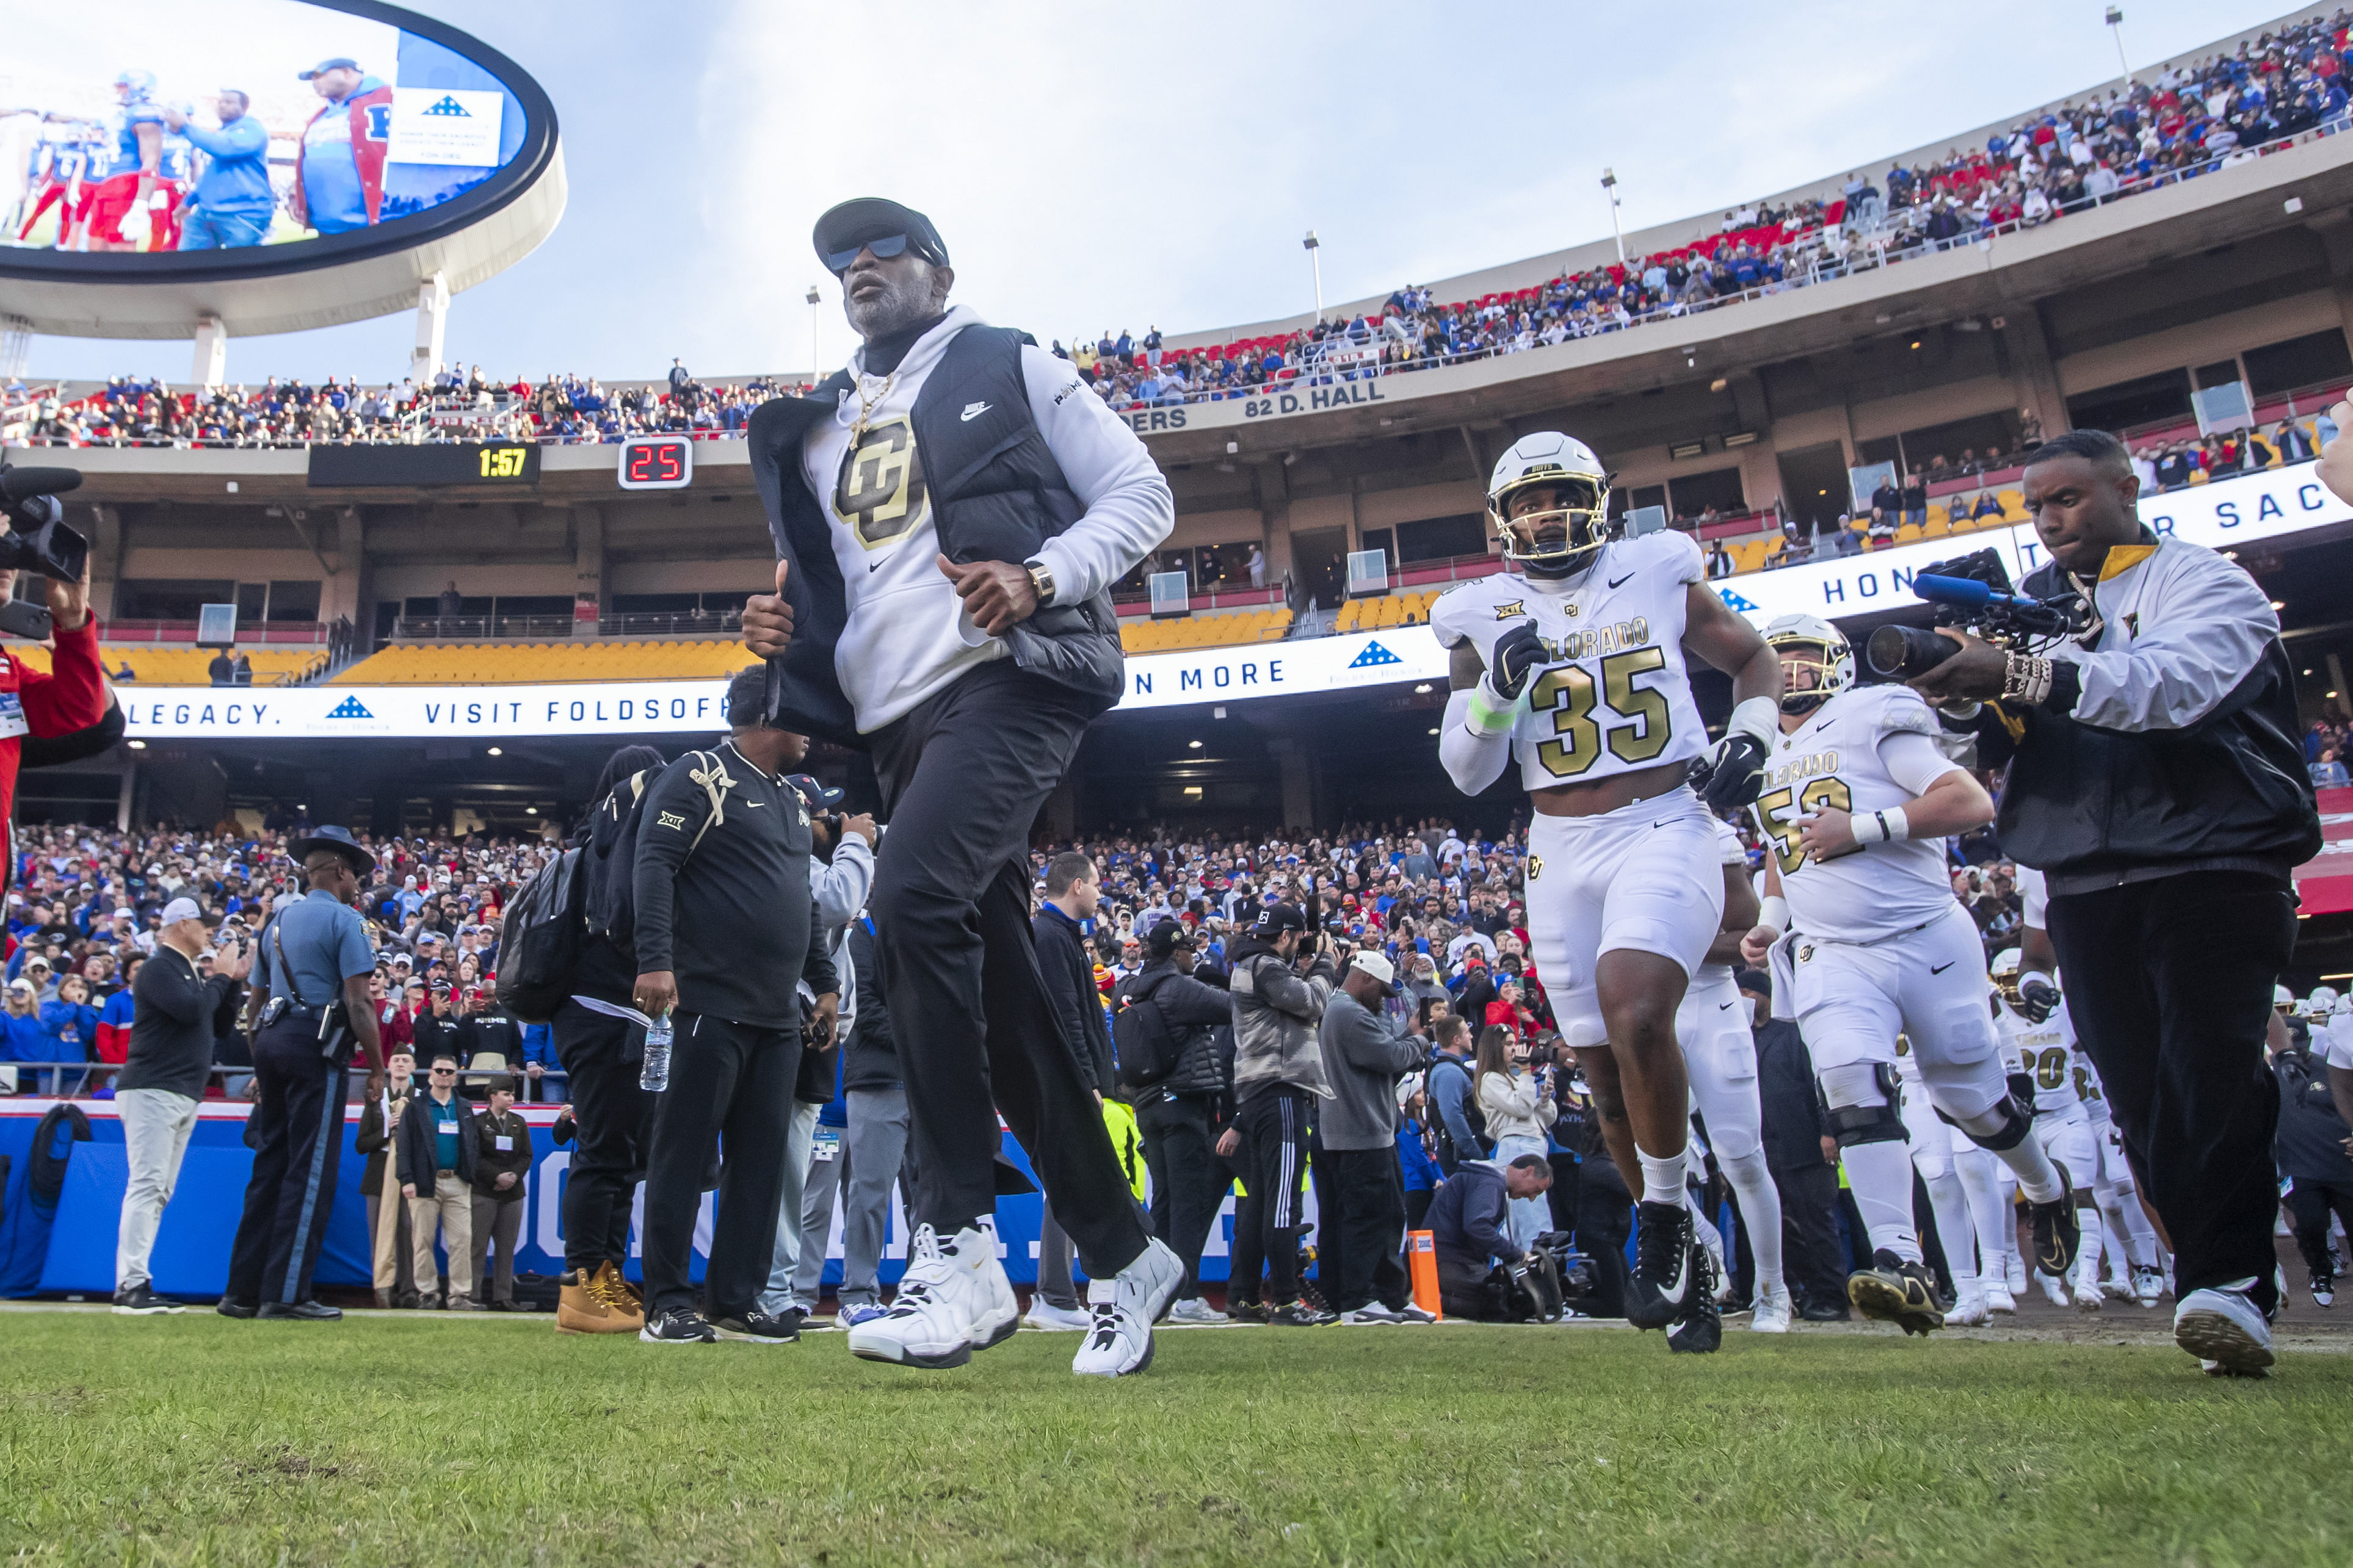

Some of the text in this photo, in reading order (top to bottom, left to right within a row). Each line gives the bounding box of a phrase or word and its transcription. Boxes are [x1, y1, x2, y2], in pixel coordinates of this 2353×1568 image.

[963, 400, 985, 413] NIKE
[1245, 381, 1385, 417] 82 D. HALL
[479, 448, 526, 477] 1:57
[631, 444, 680, 480] 25
[1531, 463, 1553, 472] BUFFS
[1539, 616, 1649, 662] LORADO
[1181, 660, 1284, 691] MORE
[128, 704, 281, 724] LEGACY.
[426, 697, 730, 723] VISIT FOLDSOFH
[1529, 645, 1672, 779] 35
[1763, 751, 1838, 790] LORADO
